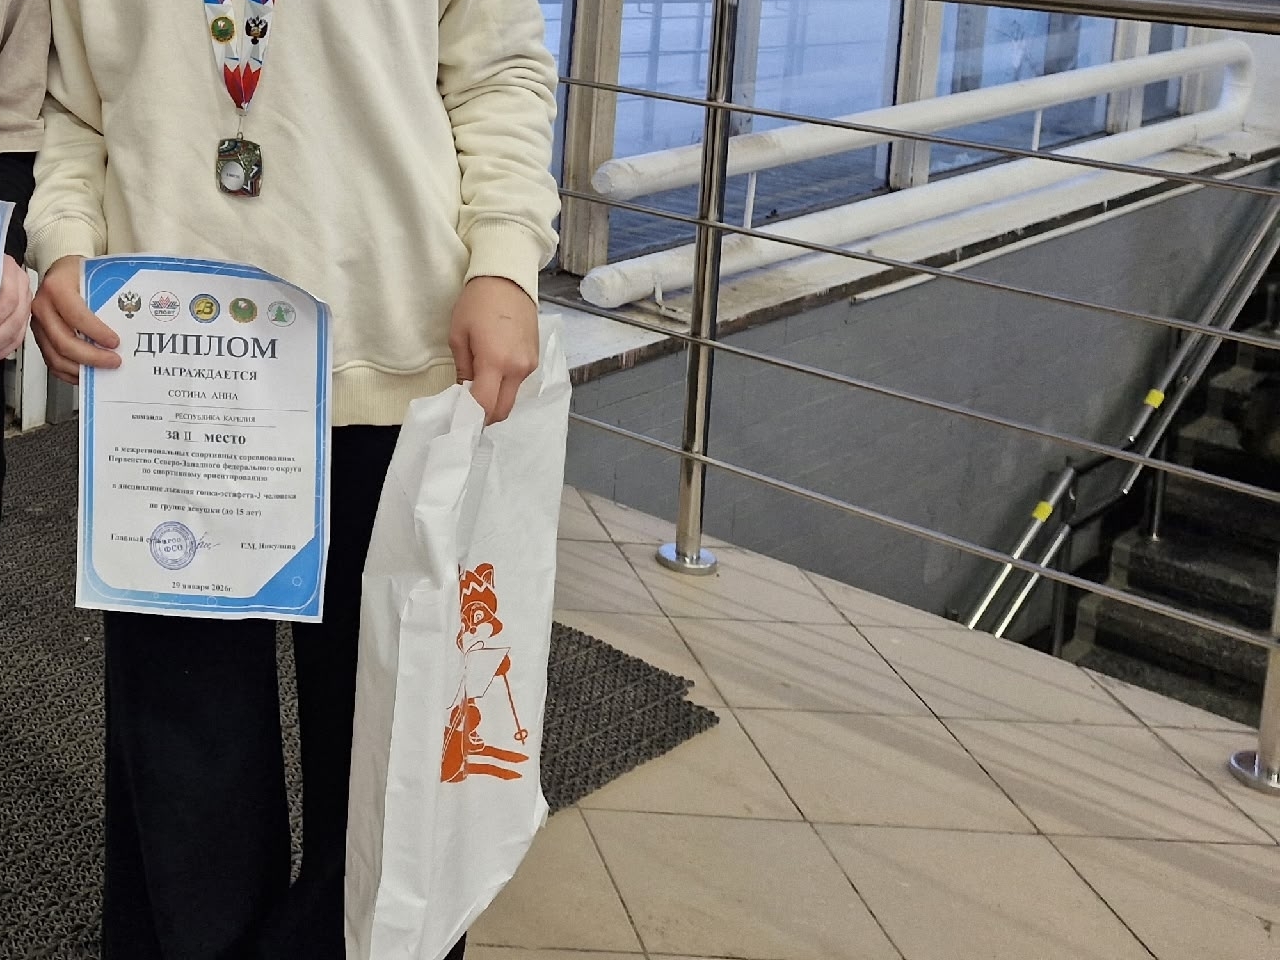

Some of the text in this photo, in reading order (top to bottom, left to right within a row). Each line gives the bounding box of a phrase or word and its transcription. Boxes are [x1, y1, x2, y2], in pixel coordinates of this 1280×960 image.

[133, 332, 278, 359] ДИПЛОМ
[153, 366, 257, 380] НАГРАЖДАЕТСЯ
[168, 390, 238, 400] СОТИНА АННА
[175, 413, 220, 421] РЕСПУБЛИКА
[223, 414, 256, 423] КАРЕЛИЯ
[166, 430, 179, 440] за
[204, 433, 246, 444] место
[121, 446, 189, 457] межрегиональных
[108, 455, 152, 465] Первенство
[223, 462, 275, 472] федерального
[111, 533, 144, 543] Главный
